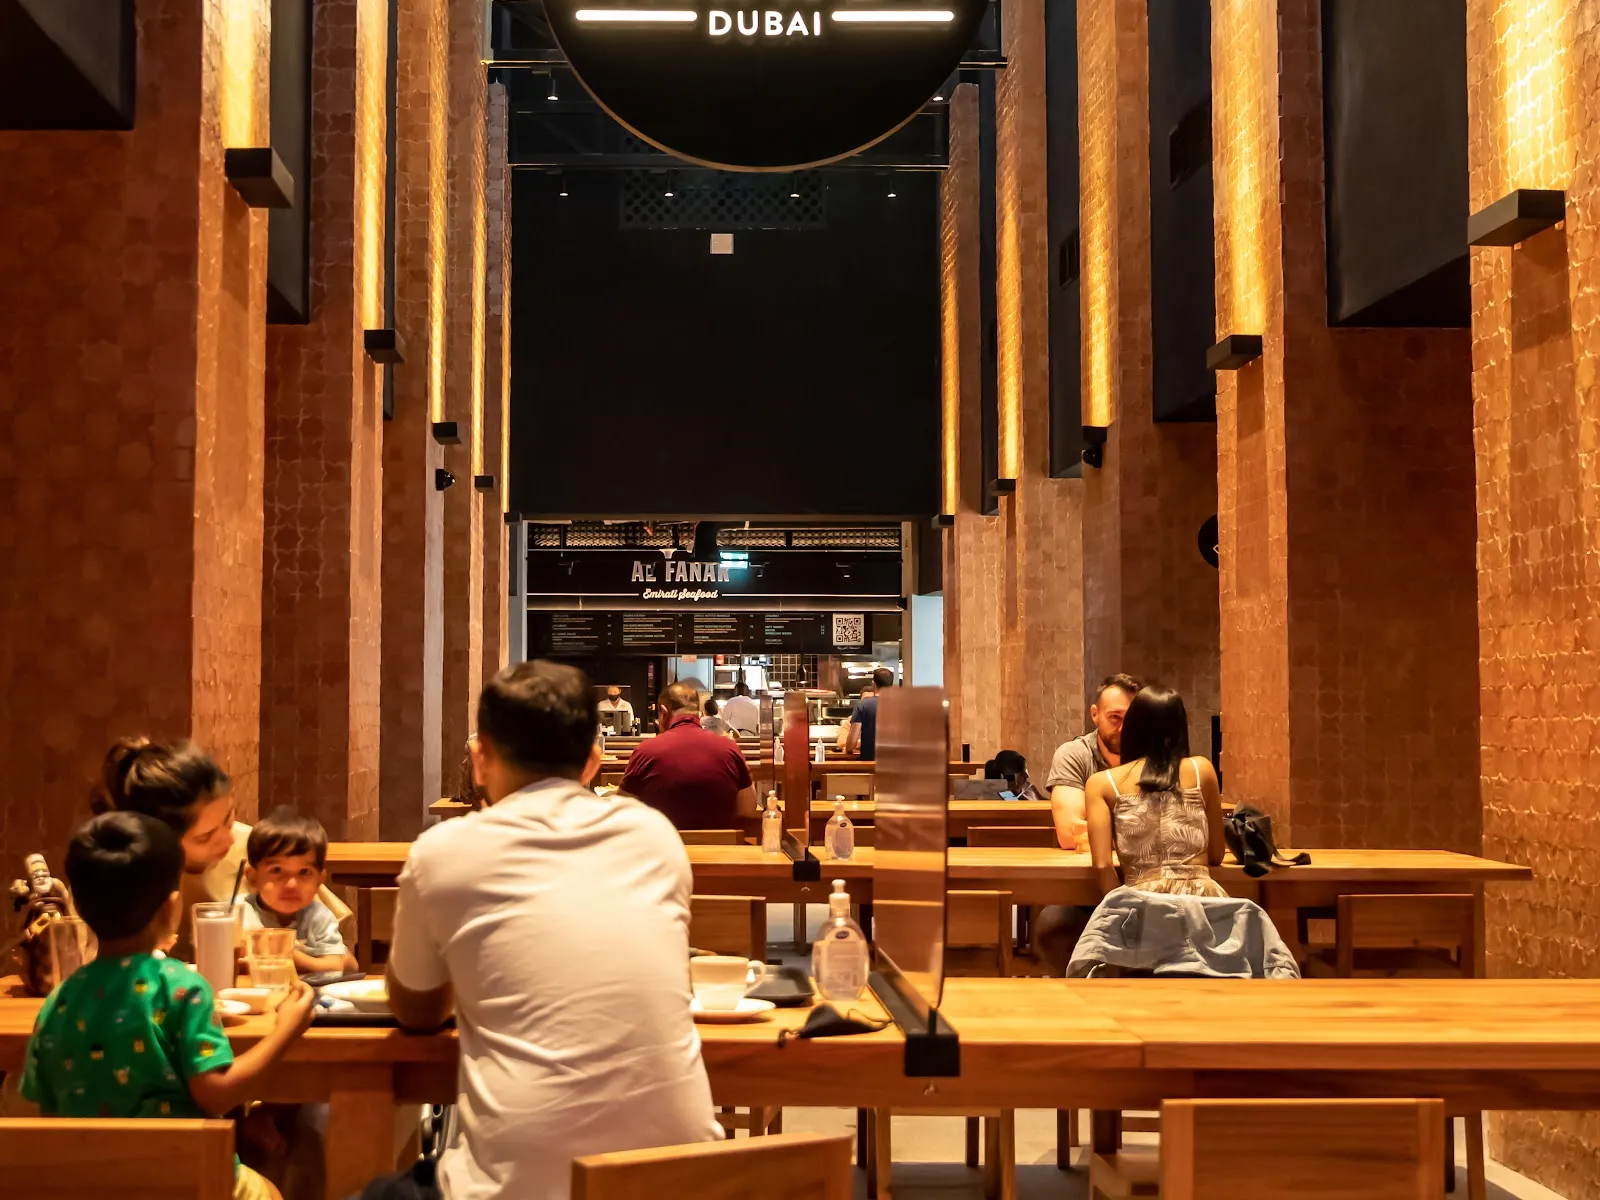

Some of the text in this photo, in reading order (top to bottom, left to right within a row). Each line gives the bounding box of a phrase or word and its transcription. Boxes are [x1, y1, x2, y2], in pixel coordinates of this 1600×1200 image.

[707, 9, 822, 37] DUBAI
[664, 560, 730, 583] FANAR
[642, 587, 719, 601] Emirati Seafood
